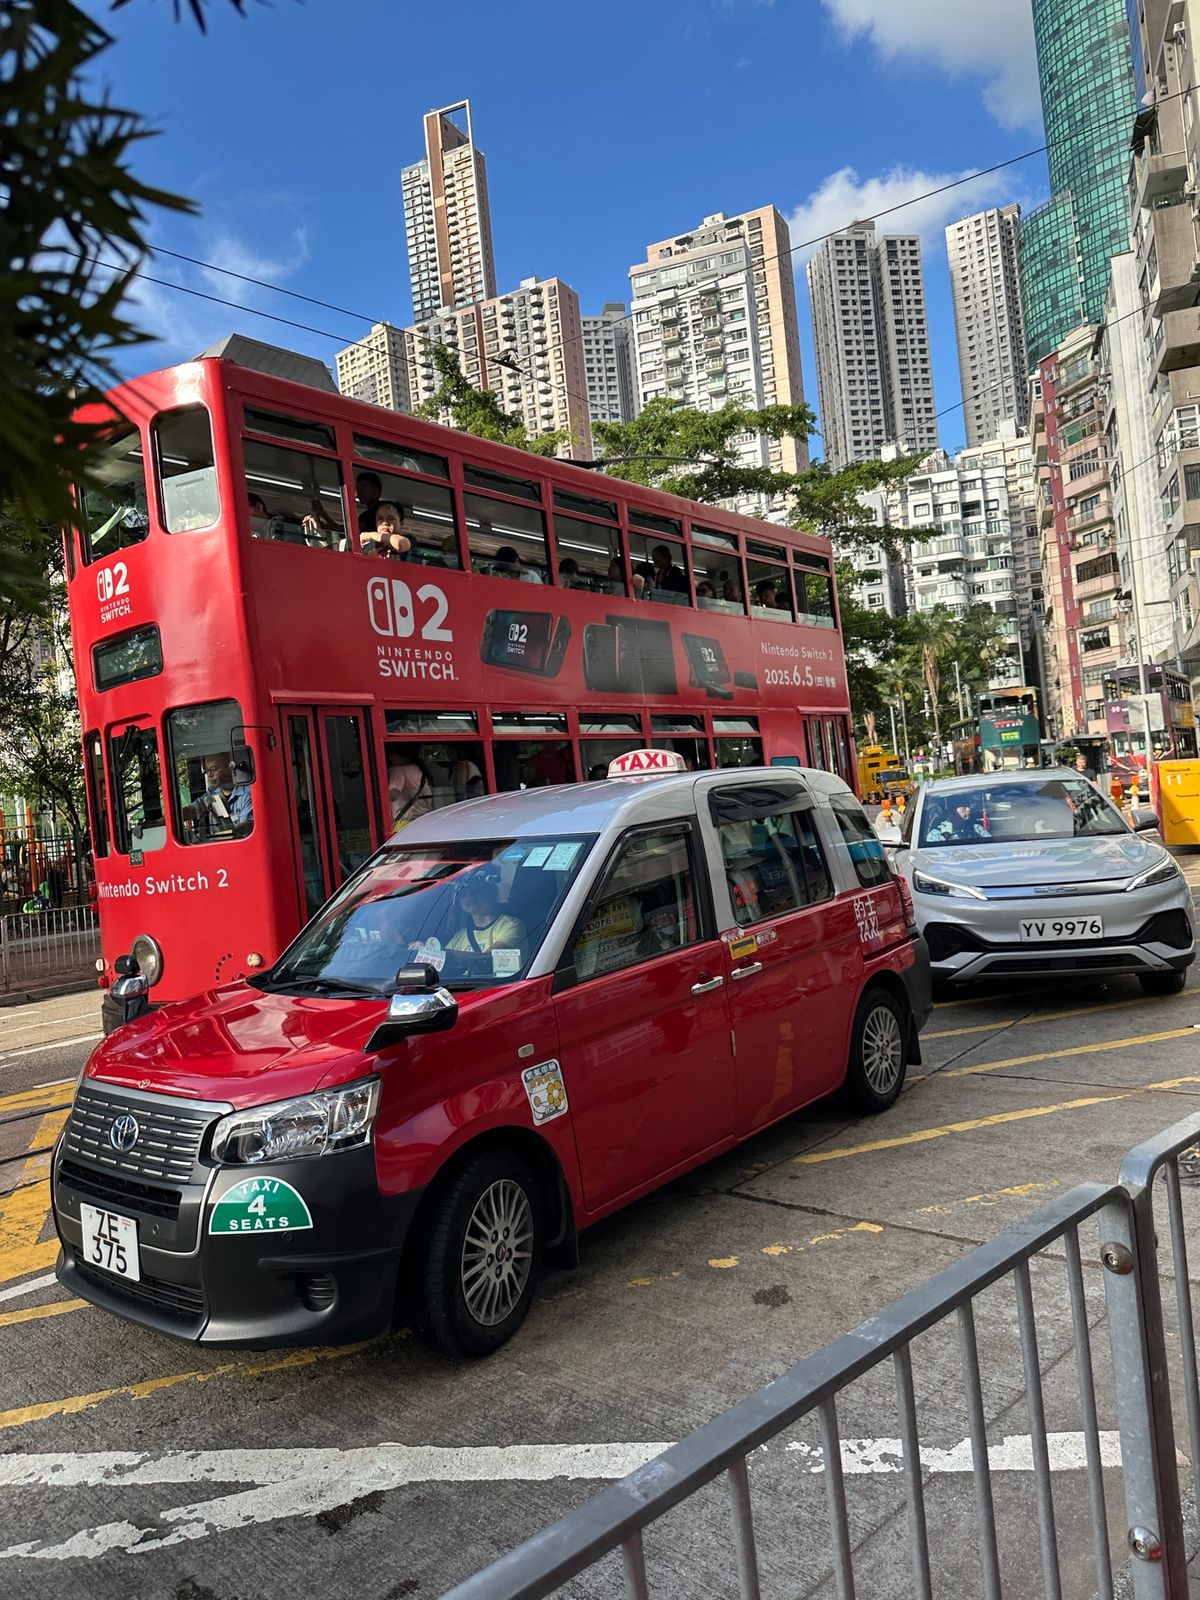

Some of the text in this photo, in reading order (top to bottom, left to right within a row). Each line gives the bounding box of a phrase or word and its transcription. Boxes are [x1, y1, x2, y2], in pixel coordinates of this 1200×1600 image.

[113, 562, 130, 596] 2
[101, 604, 131, 623] SWITCH
[416, 584, 453, 642] 2
[377, 646, 452, 661] NINTENDO
[761, 642, 834, 660] Nintendo Switch 2
[378, 659, 455, 680] SWITCH
[764, 665, 814, 687] 2025.6.5
[616, 752, 668, 771] TAXI
[98, 868, 229, 898] Nintendo Switch 2
[853, 893, 877, 920] 的士
[857, 914, 881, 943] TAXI
[1022, 920, 1101, 938] YV 9976
[240, 1179, 280, 1195] TAXI
[247, 1194, 267, 1216] 4
[96, 1205, 120, 1244] ZE
[229, 1216, 289, 1230] SEATS
[92, 1235, 128, 1274] 375
